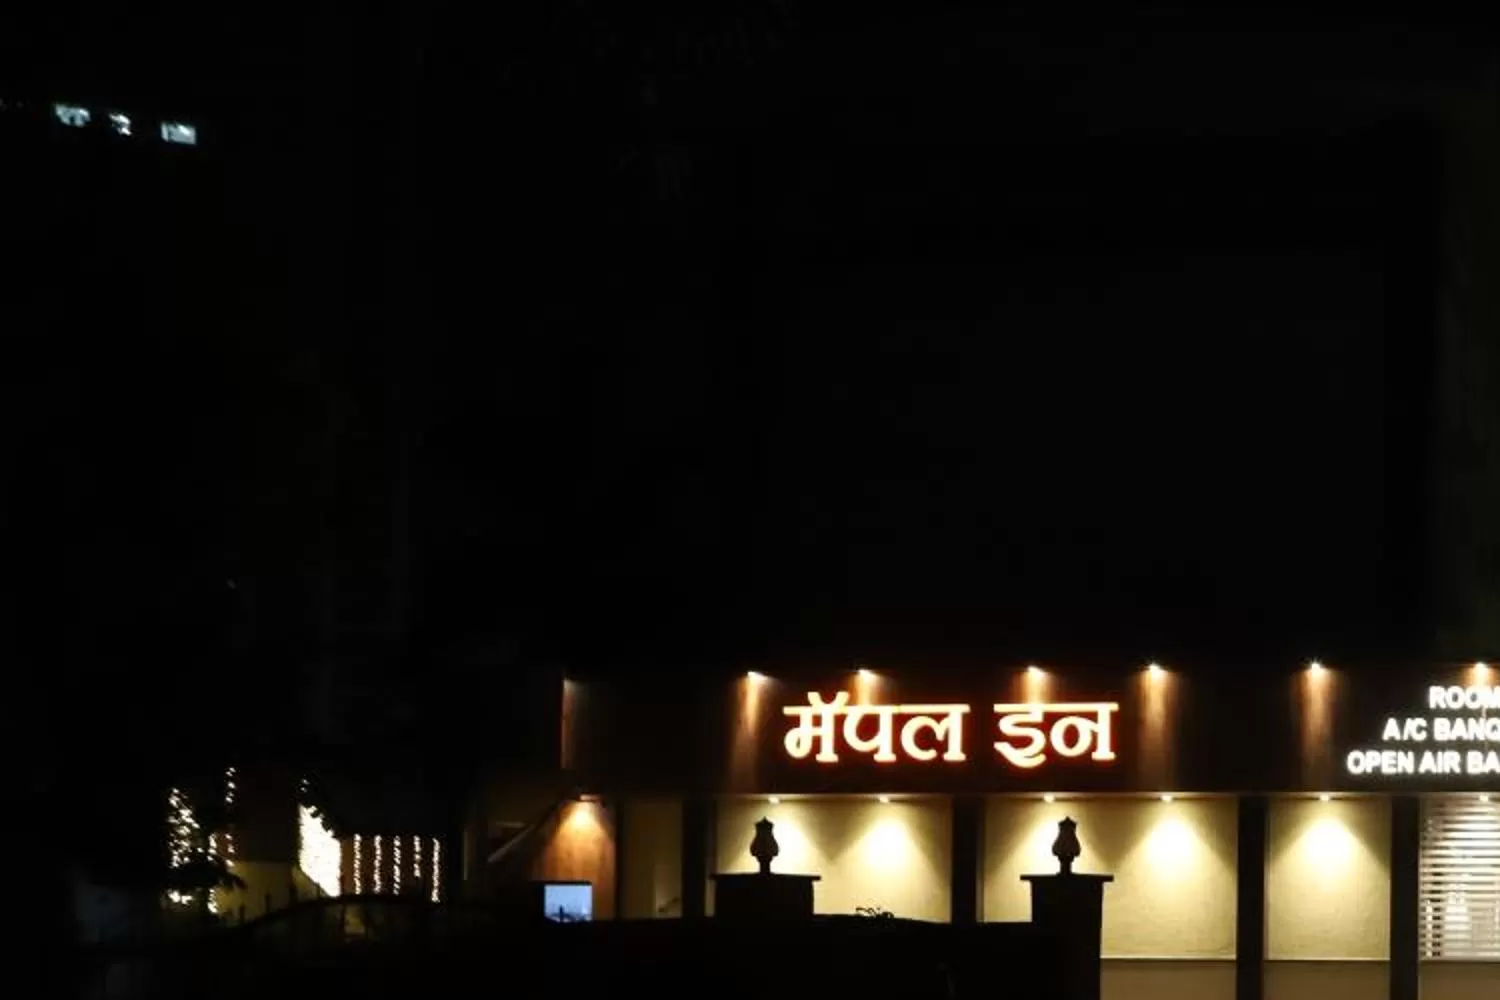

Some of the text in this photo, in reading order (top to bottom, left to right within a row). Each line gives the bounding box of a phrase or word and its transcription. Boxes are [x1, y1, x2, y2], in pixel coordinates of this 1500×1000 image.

[993, 702, 1120, 769] इन
[1382, 717, 1428, 741] A/C
[1347, 751, 1415, 774] OPEN
[1418, 751, 1461, 774] AIR
